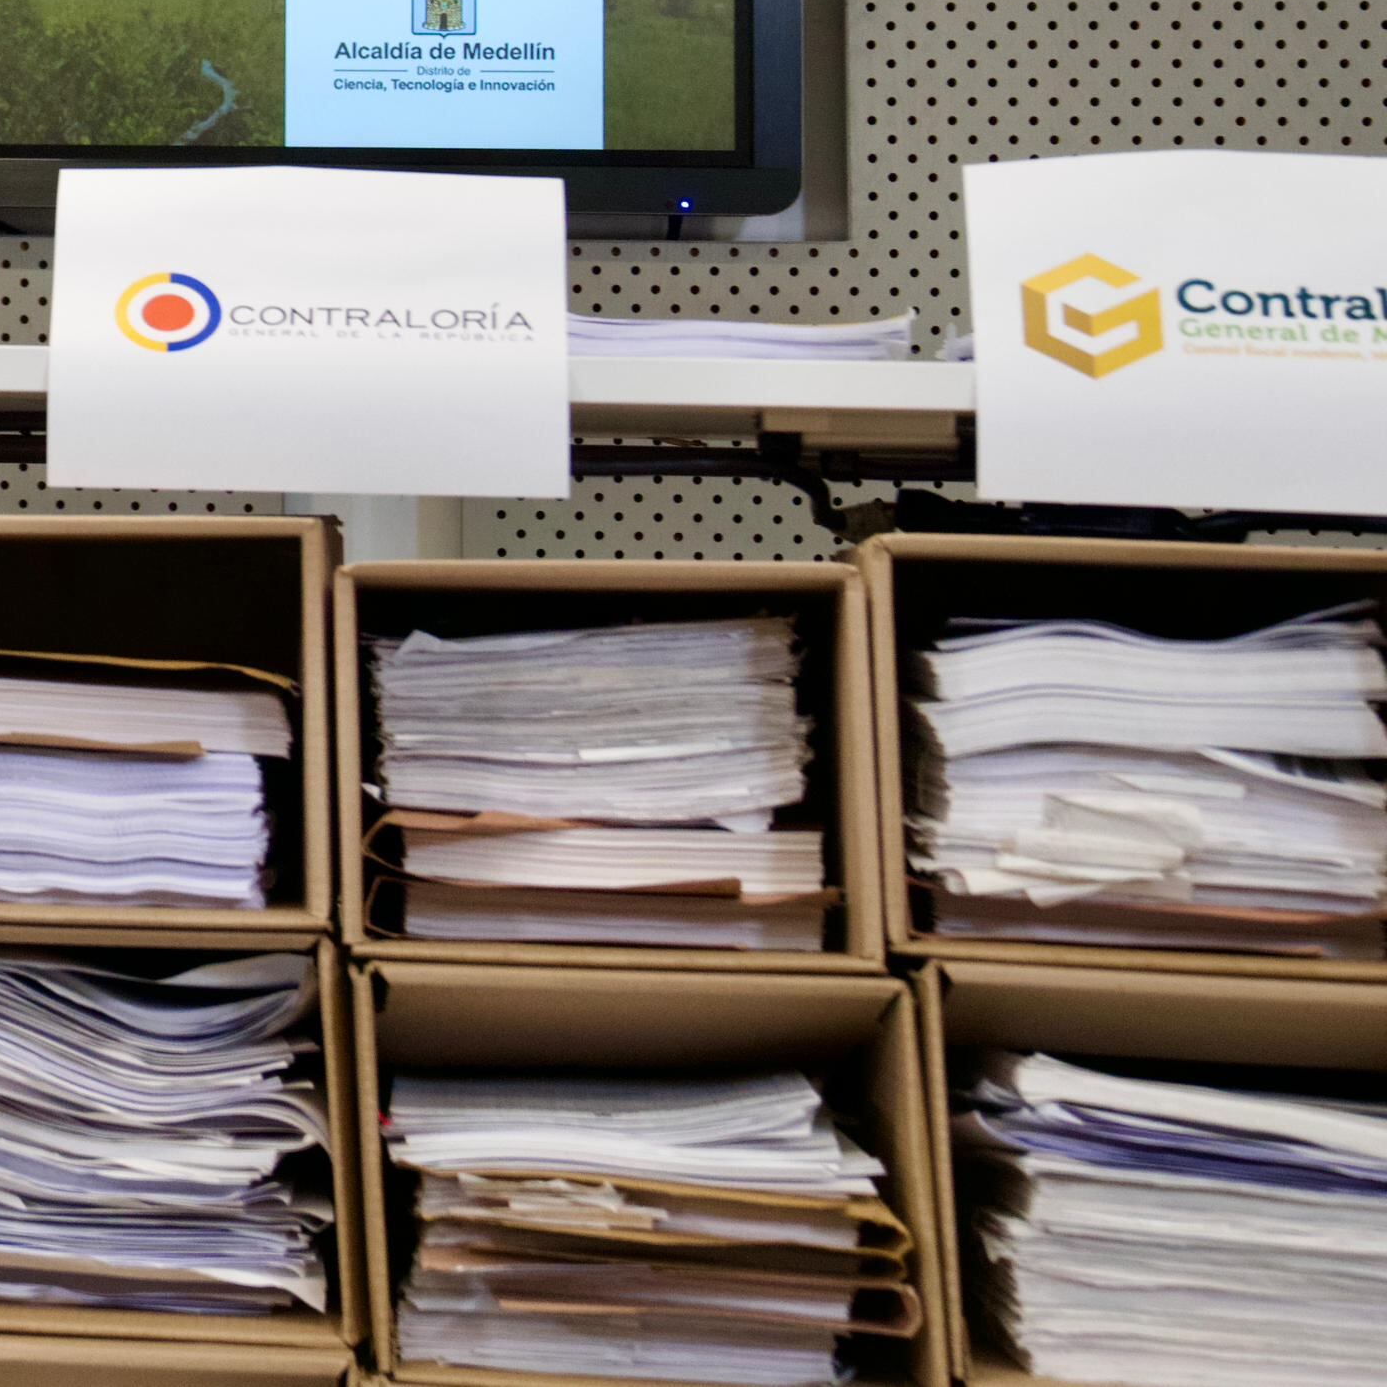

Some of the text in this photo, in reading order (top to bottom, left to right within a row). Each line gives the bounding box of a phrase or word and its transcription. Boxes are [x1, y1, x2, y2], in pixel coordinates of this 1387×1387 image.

[334, 42, 555, 60] Alcaldía de Medellín
[417, 66, 470, 76] Distrito de
[334, 79, 555, 92] Ciencia, Tecnología e Innovación
[230, 303, 533, 330] CONTRALORÍA
[1179, 317, 1308, 341] General
[1321, 325, 1359, 343] de
